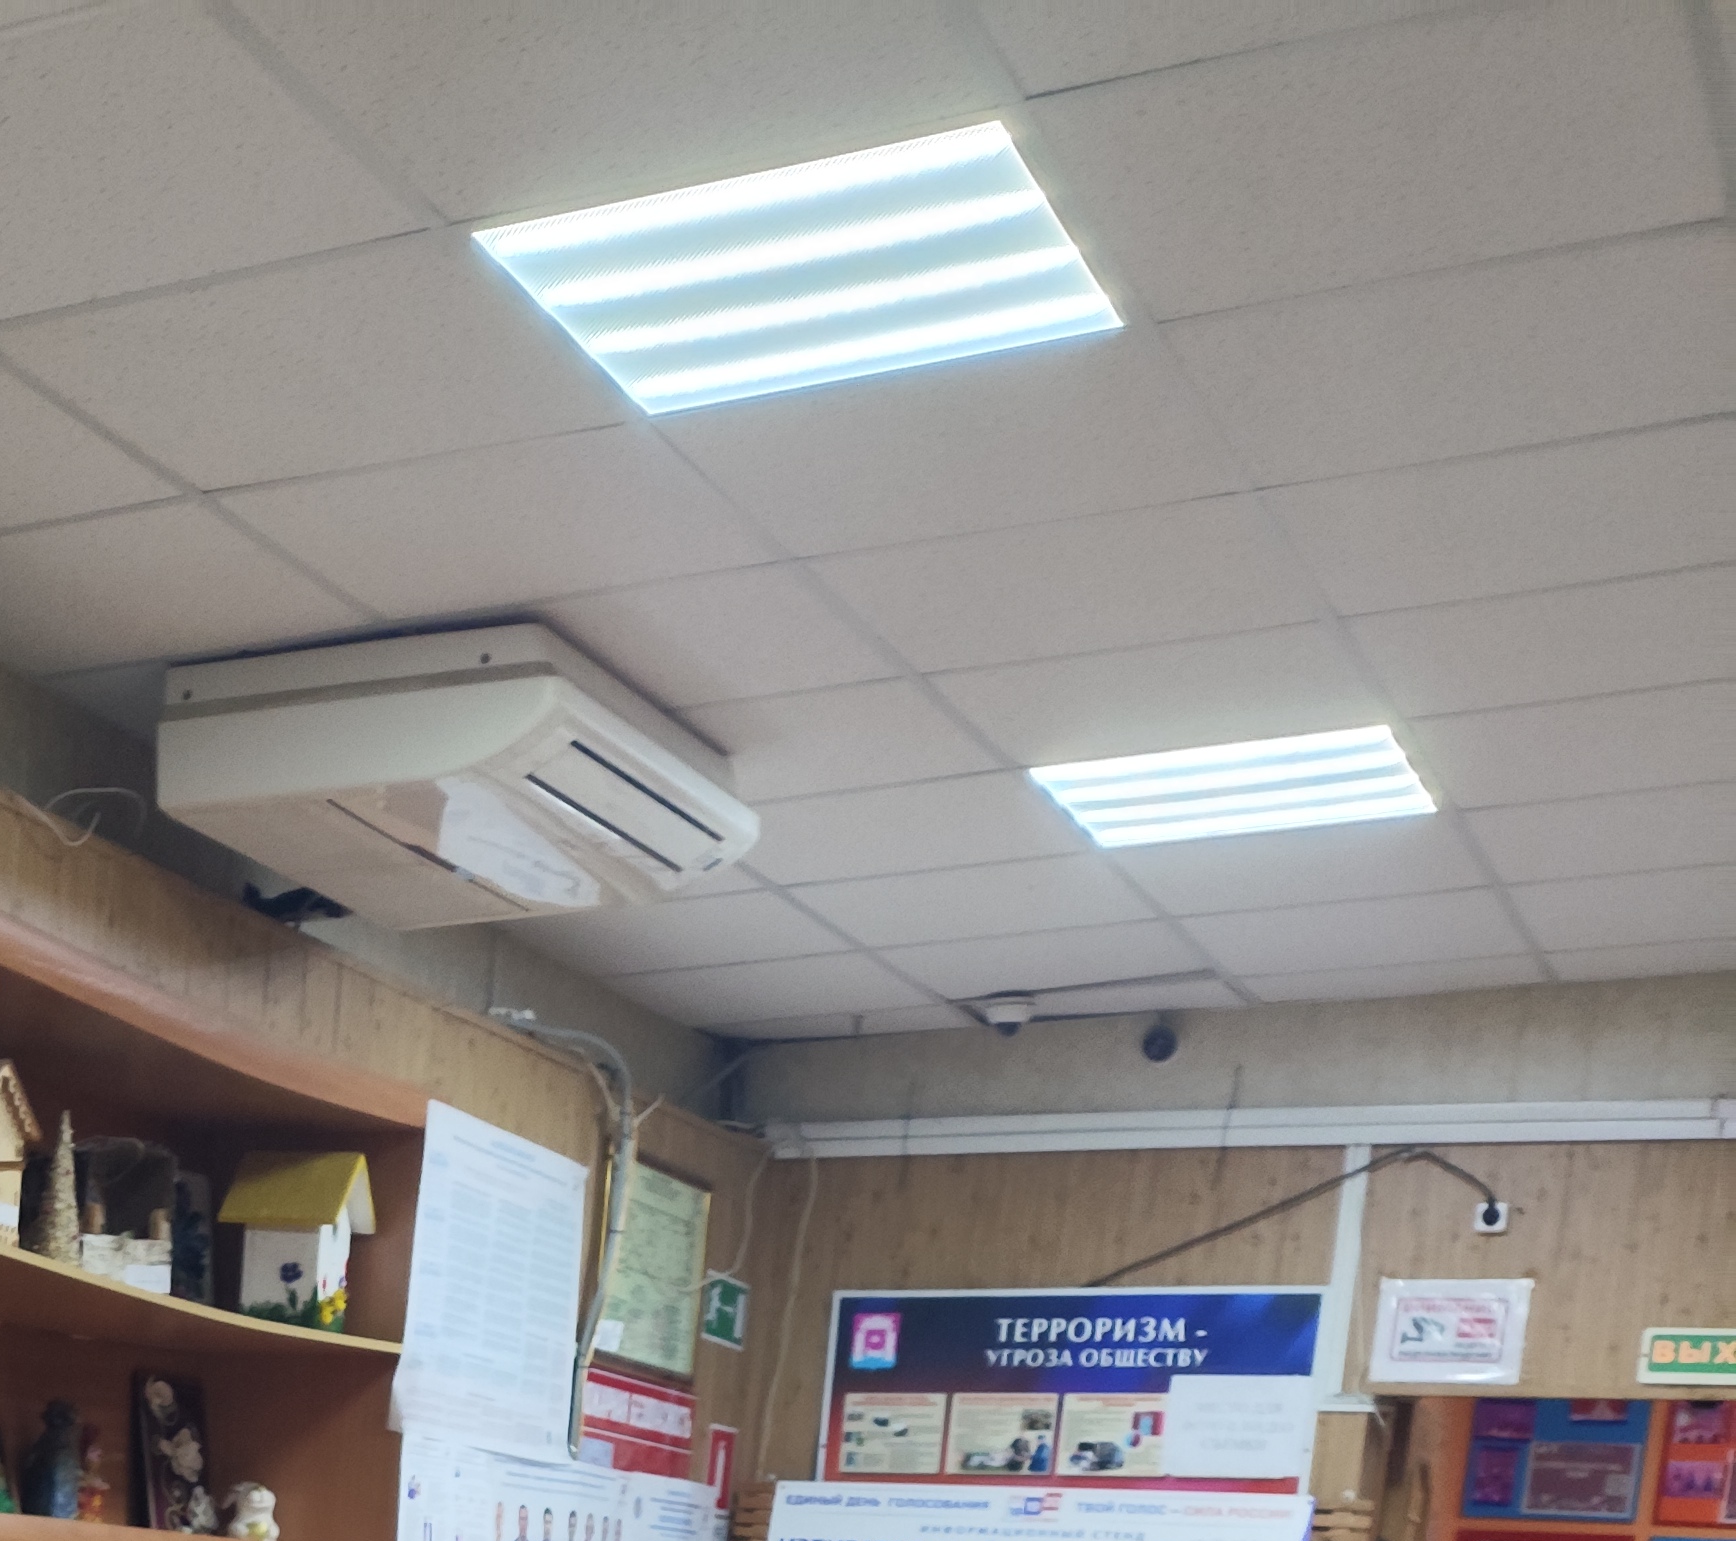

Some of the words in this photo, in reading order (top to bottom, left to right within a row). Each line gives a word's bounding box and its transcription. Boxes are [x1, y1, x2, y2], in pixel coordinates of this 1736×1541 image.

[995, 1317, 1187, 1343] ТЕРРОРИЗМ
[984, 1349, 1073, 1368] УГРОЗА
[1079, 1348, 1208, 1368] ОБЩЕСТВУ
